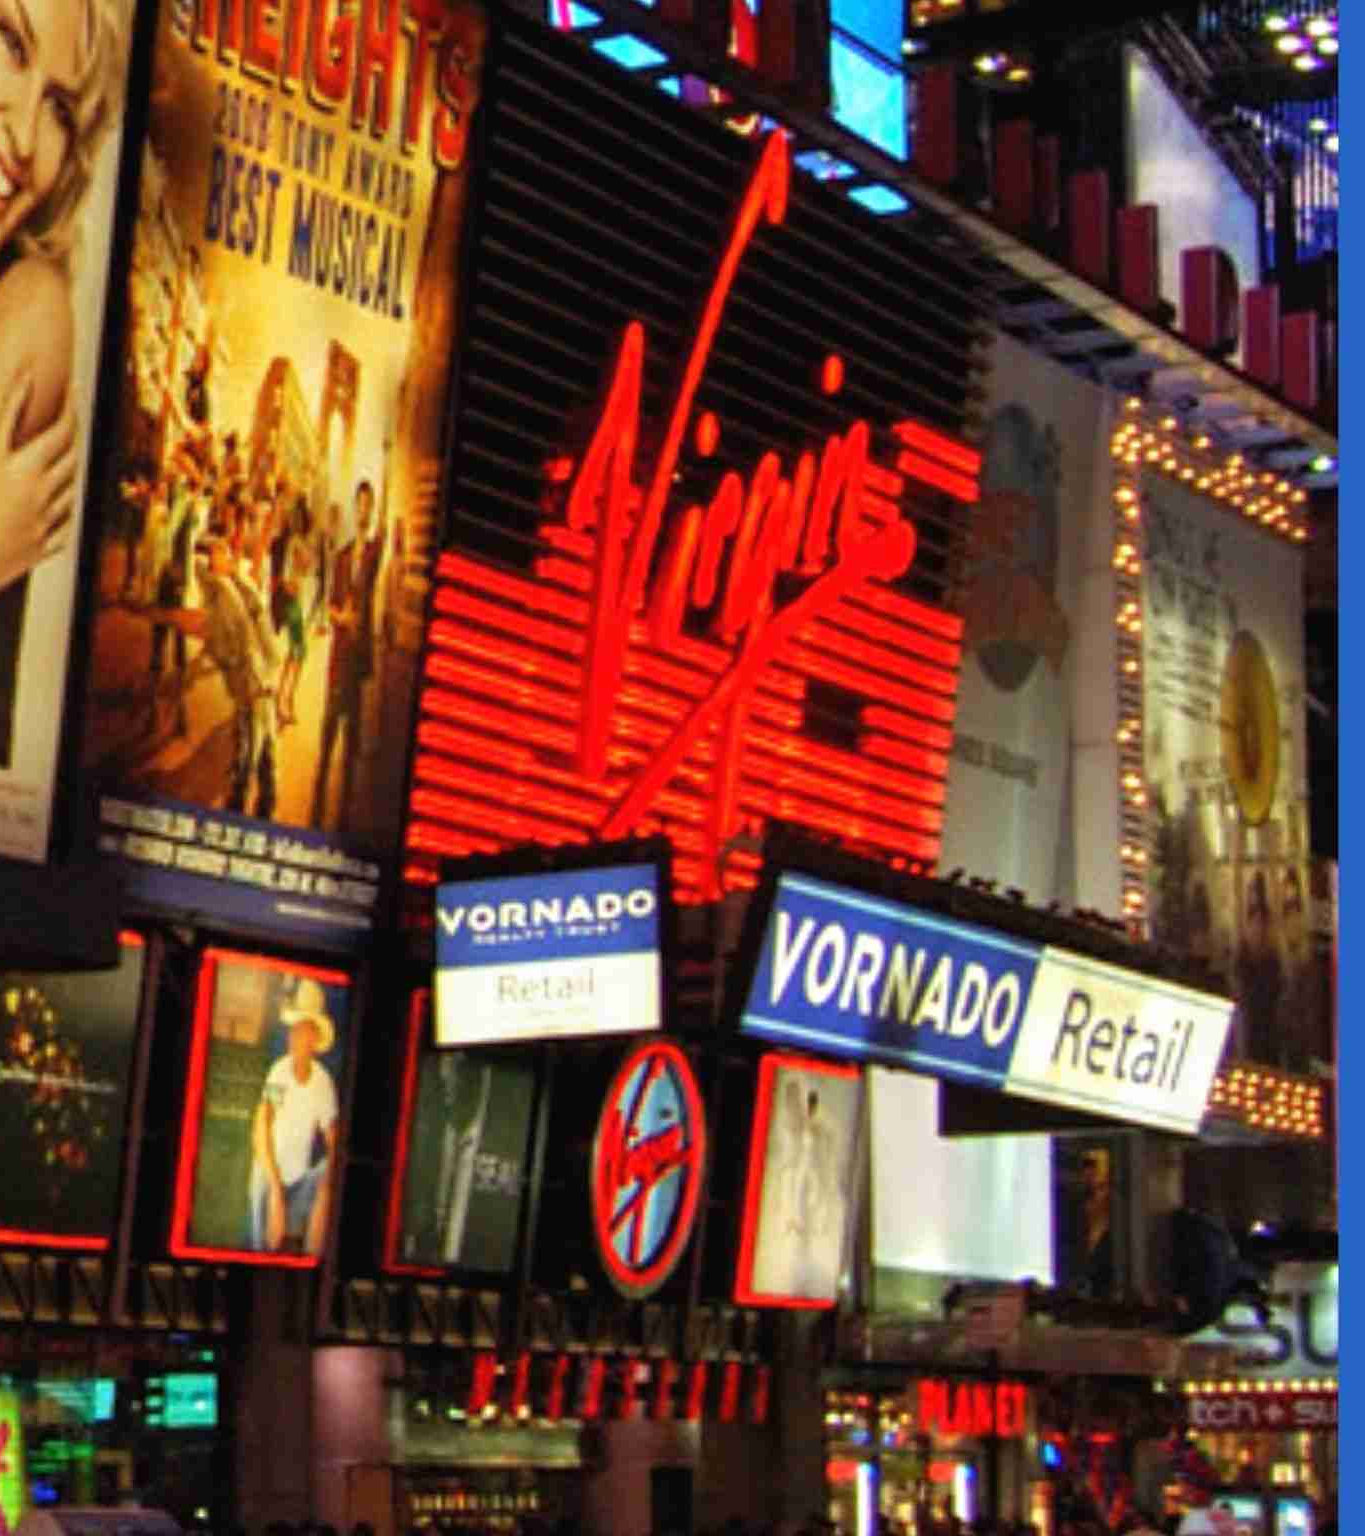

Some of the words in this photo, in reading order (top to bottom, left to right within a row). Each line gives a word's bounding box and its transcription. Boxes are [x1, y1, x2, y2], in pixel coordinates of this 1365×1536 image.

[203, 142, 282, 267] BEST
[287, 175, 407, 323] MUSICAL
[437, 888, 655, 938] VORNADO
[771, 910, 1022, 1050] VORNADO
[1049, 988, 1194, 1093] Retail
[917, 1378, 1027, 1439] PLANET
